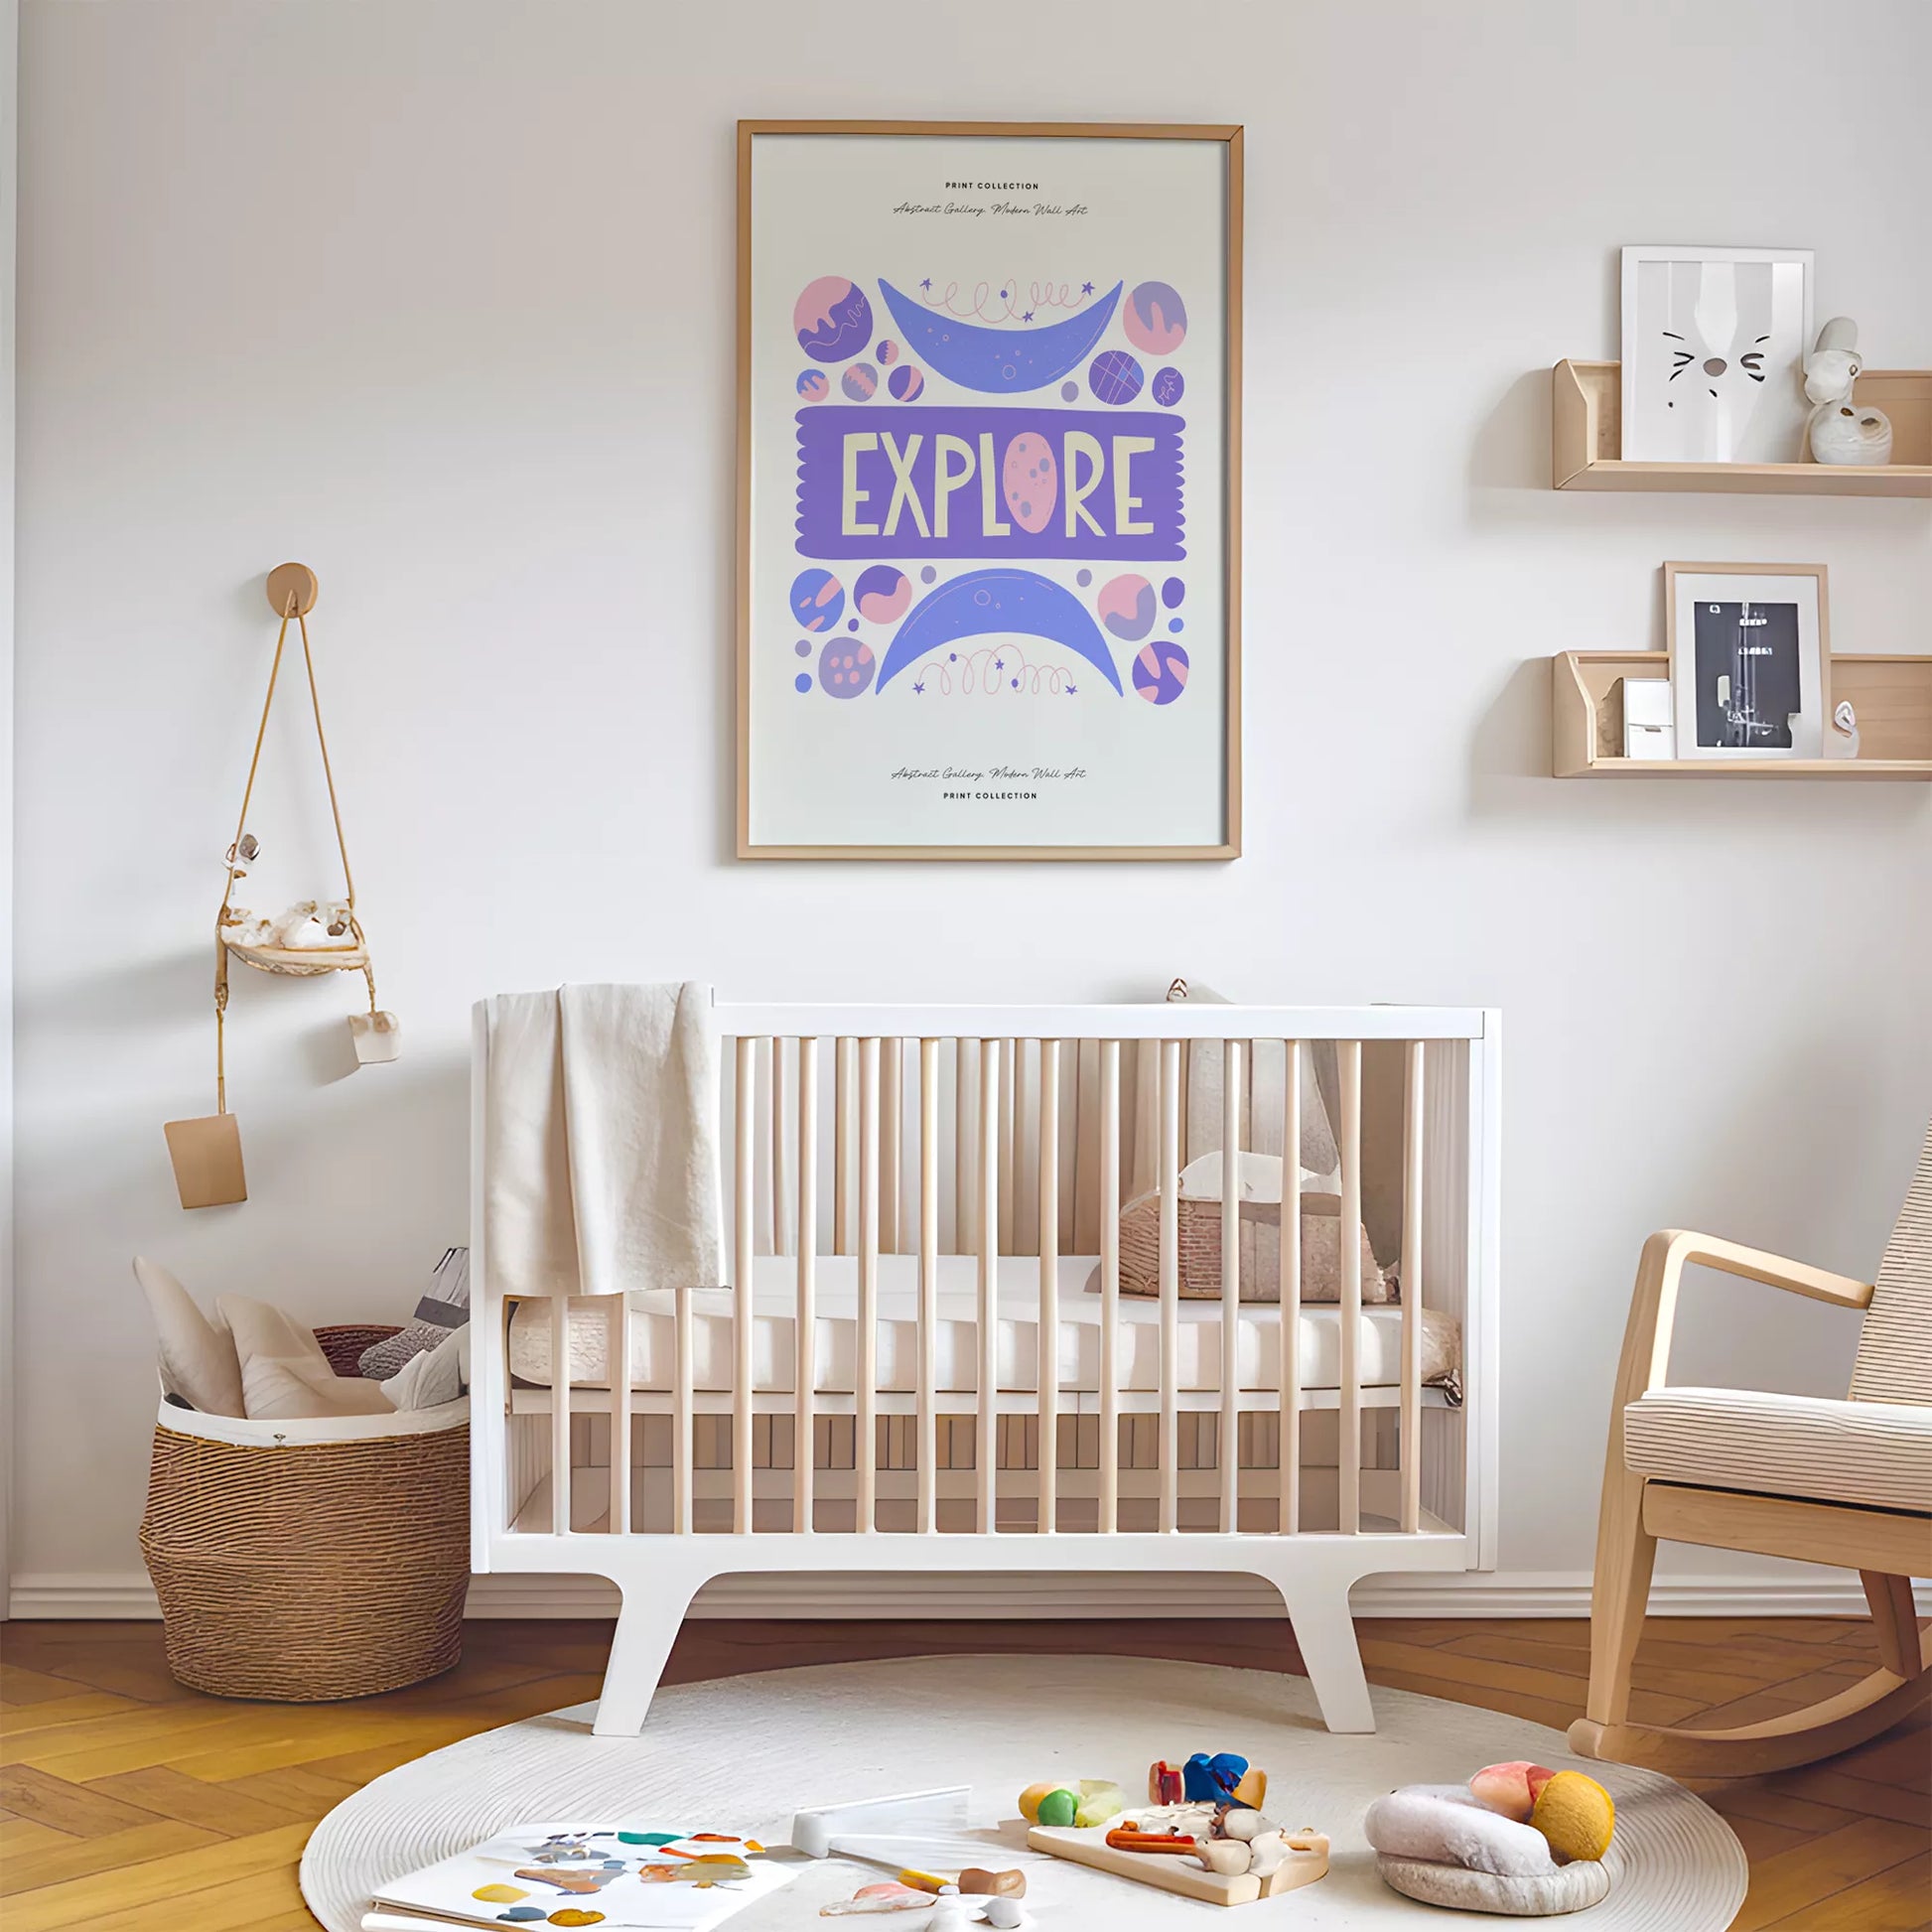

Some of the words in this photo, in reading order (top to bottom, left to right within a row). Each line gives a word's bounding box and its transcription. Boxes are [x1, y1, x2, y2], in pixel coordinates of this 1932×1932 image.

[977, 182, 1039, 191] COLLECTION
[893, 202, 941, 215] Abstract
[991, 202, 1031, 215] Modern
[1034, 204, 1062, 215] Wall
[1065, 204, 1088, 215] Art
[842, 431, 1156, 538] EXPLORE
[891, 766, 939, 780] Abstract
[989, 765, 1029, 779] Modern
[1032, 767, 1060, 779] Wall
[1063, 766, 1086, 779] Art
[943, 791, 972, 800] PRINT
[975, 791, 1037, 800] COLLECTION
